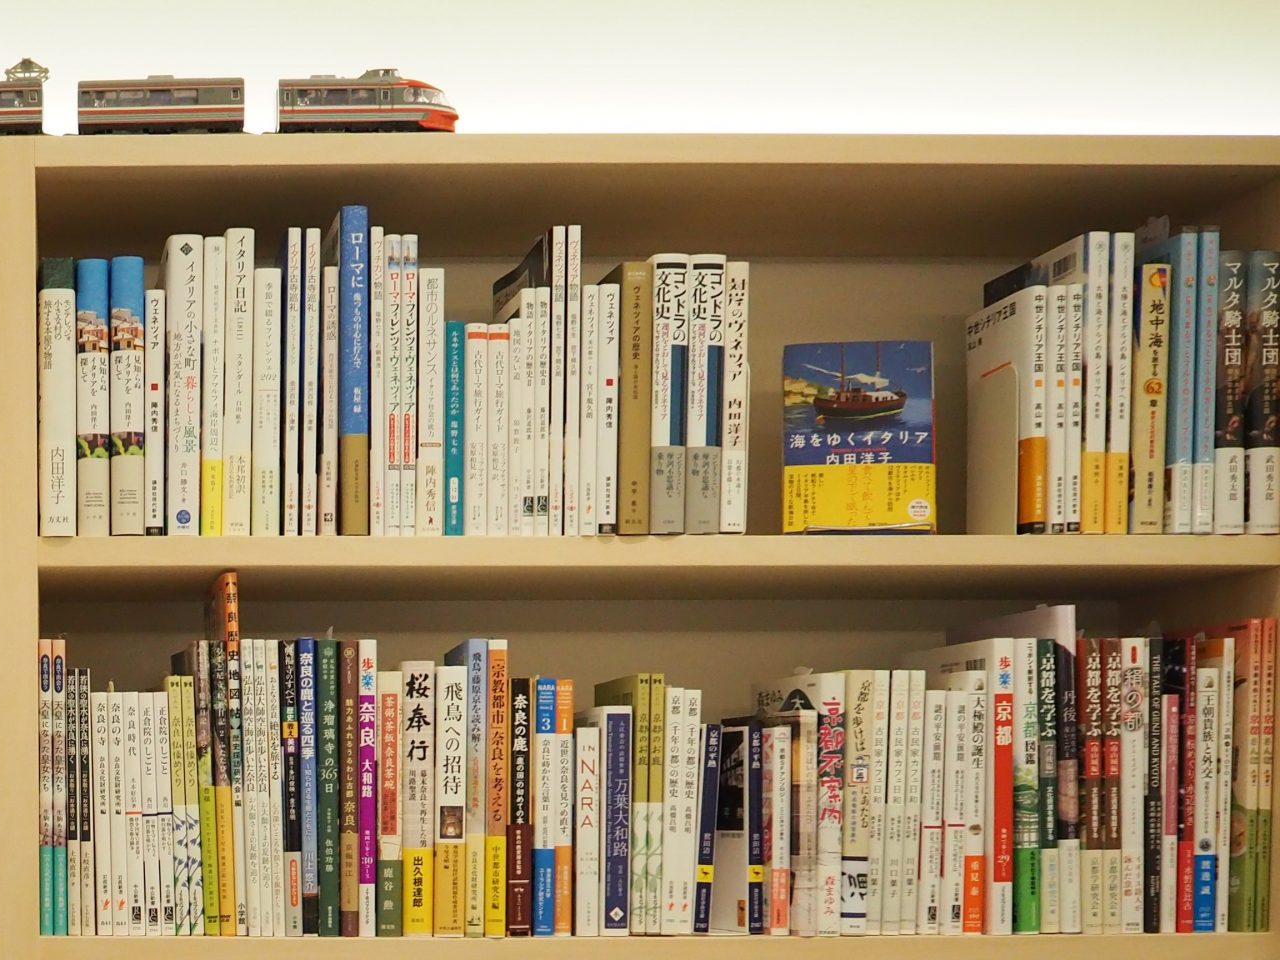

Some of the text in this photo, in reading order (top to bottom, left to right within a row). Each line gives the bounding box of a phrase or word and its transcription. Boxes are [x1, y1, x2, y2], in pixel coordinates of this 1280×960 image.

[233, 236, 247, 314] イタリア日記
[351, 233, 363, 288] ローマに
[655, 271, 671, 320] 文化史
[692, 271, 708, 320] 文化史
[44, 300, 53, 370] 旅する本屋の物語
[151, 299, 159, 349] ヴェネツィア
[425, 277, 438, 375] 都市のルネサンス
[632, 286, 640, 360] ヴェネツィアの歴史
[674, 272, 687, 343] ゴンドラの
[1222, 262, 1243, 366] マルタ騎士団
[80, 358, 88, 383] 探して
[99, 357, 107, 391] 見知らぬ
[183, 262, 198, 453] イタリアの小さな町 暮らしと風景
[473, 351, 483, 432] 古代ローマ旅行ガイド
[790, 431, 929, 449] 海をゆくイタリア
[51, 447, 65, 505] 内田洋子
[96, 702, 106, 747] 奈良の寺
[299, 652, 314, 760] 奈良の鹿と巡る四季
[405, 673, 431, 763] 桜奉行
[512, 693, 529, 753] 奈良の鹿
[995, 700, 1013, 745] 京都
[1039, 653, 1056, 737] 京都を学ぶ
[1123, 668, 1144, 732] 絹の都
[127, 706, 136, 757] 奈良時代
[143, 707, 152, 776] 正倉院のしごと
[359, 702, 375, 799] 奈良 大和路
[443, 682, 463, 796] 飛鳥への招待
[818, 695, 844, 825] 京都不案内
[972, 696, 984, 769] 大極殿の誕生
[1200, 693, 1215, 779] 王朝貴族と外交
[580, 744, 595, 829] IN NARA
[613, 777, 629, 857] 万葉大和路
[412, 855, 424, 908] 出久根達郎
